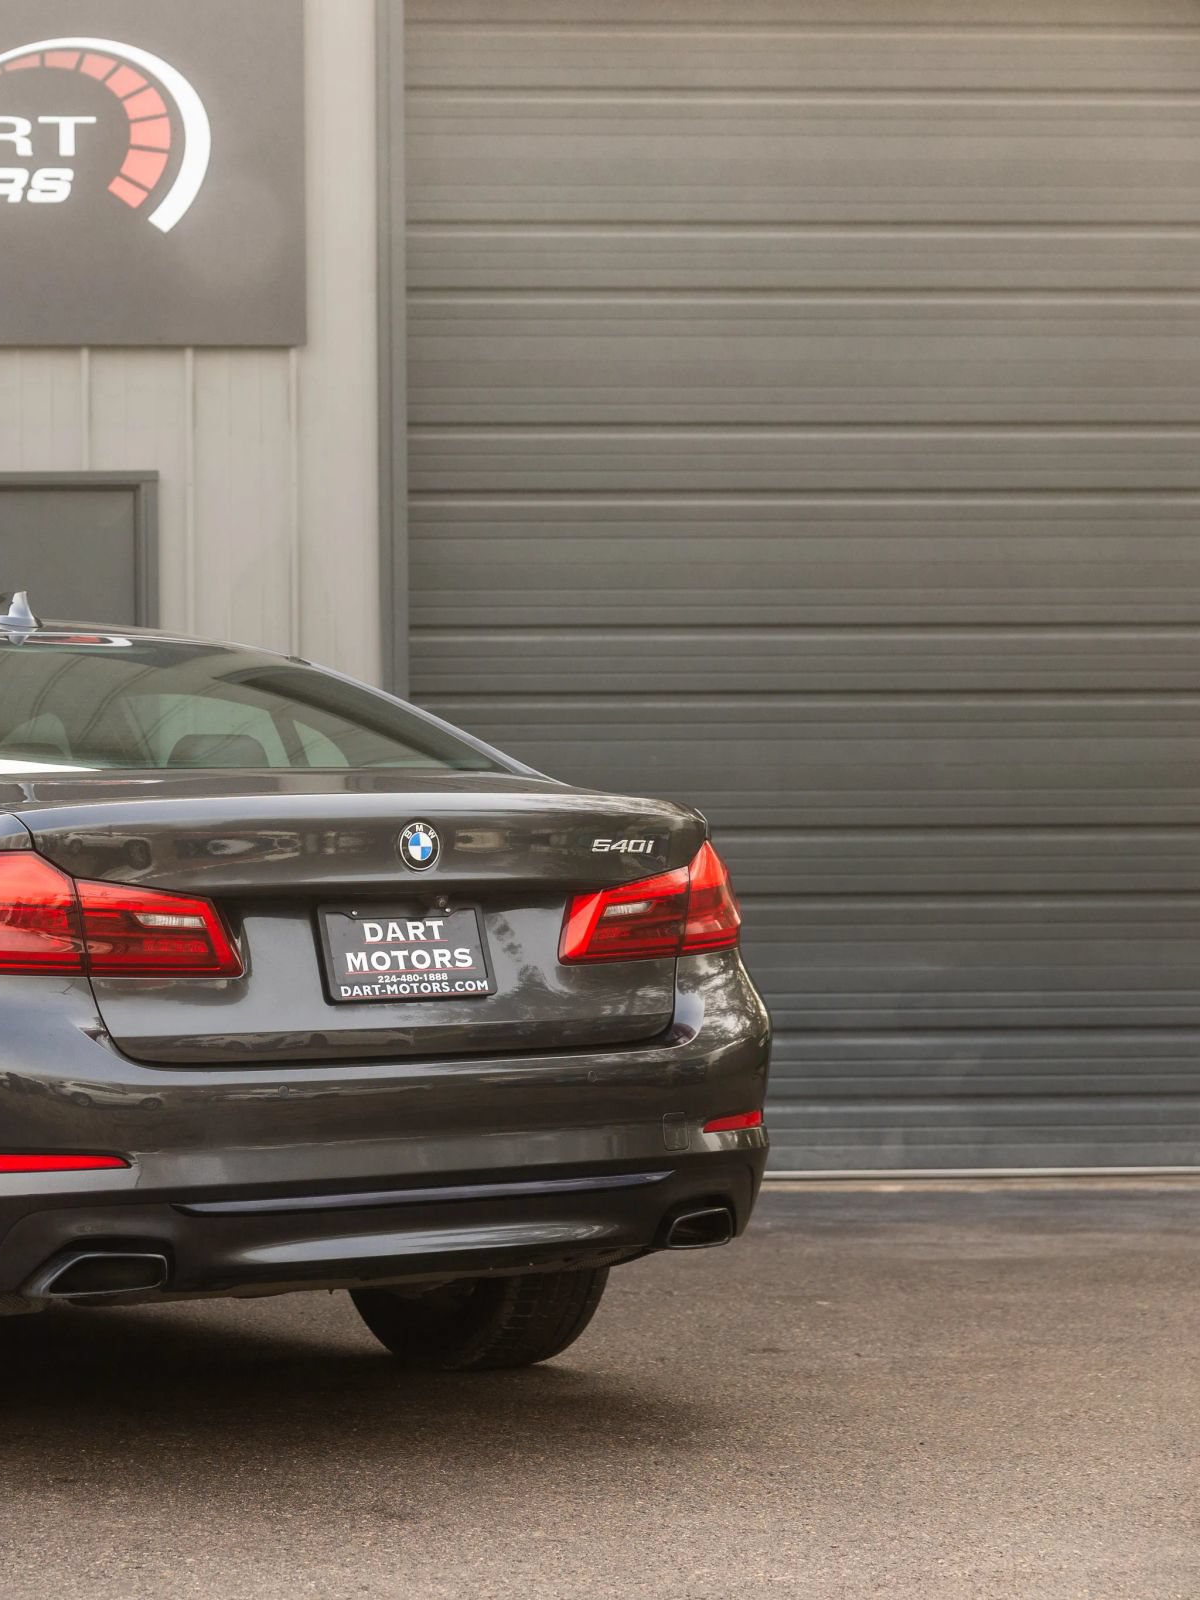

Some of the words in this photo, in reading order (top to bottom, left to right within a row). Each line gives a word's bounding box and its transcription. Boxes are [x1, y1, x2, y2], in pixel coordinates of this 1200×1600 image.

[404, 824, 436, 840] BMW
[591, 838, 655, 854] 540i
[362, 920, 444, 943] DART
[345, 948, 473, 973] MOTORS
[377, 972, 449, 983] 224-480-1888
[340, 980, 489, 997] DART-MOTORS.COM
